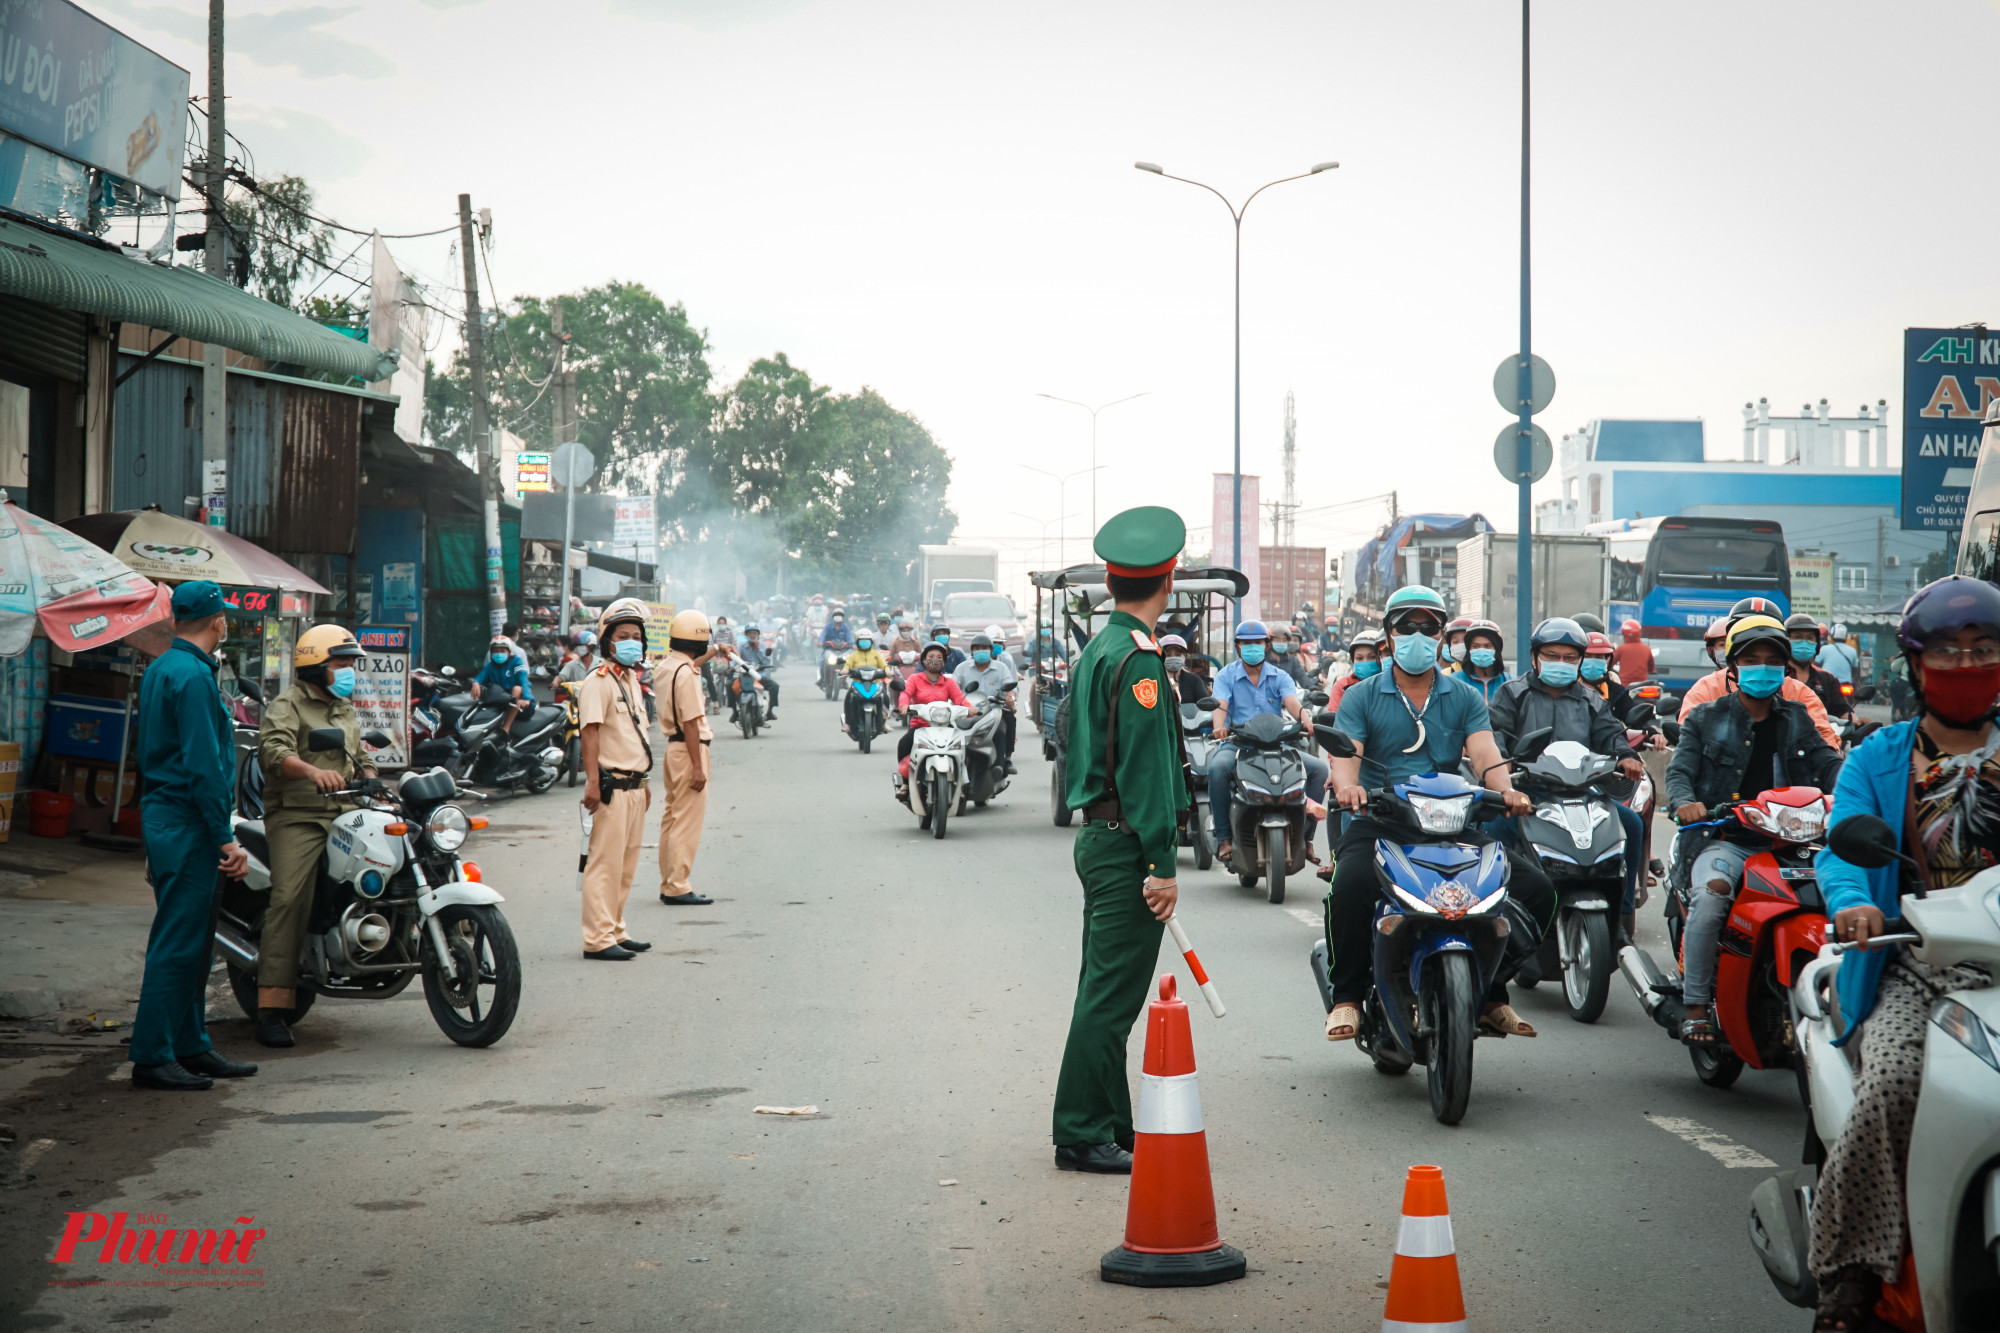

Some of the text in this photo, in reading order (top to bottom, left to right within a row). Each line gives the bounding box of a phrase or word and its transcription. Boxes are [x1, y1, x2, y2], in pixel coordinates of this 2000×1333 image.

[22, 40, 62, 107] ĐÔI
[64, 91, 101, 147] PEPSI
[1917, 337, 1974, 364] AH
[1919, 434, 1948, 457] AN
[1934, 492, 1966, 503] QUYẾT
[1916, 504, 1936, 515] CHỦ
[360, 632, 386, 646] ANH
[372, 654, 404, 673] XÀO
